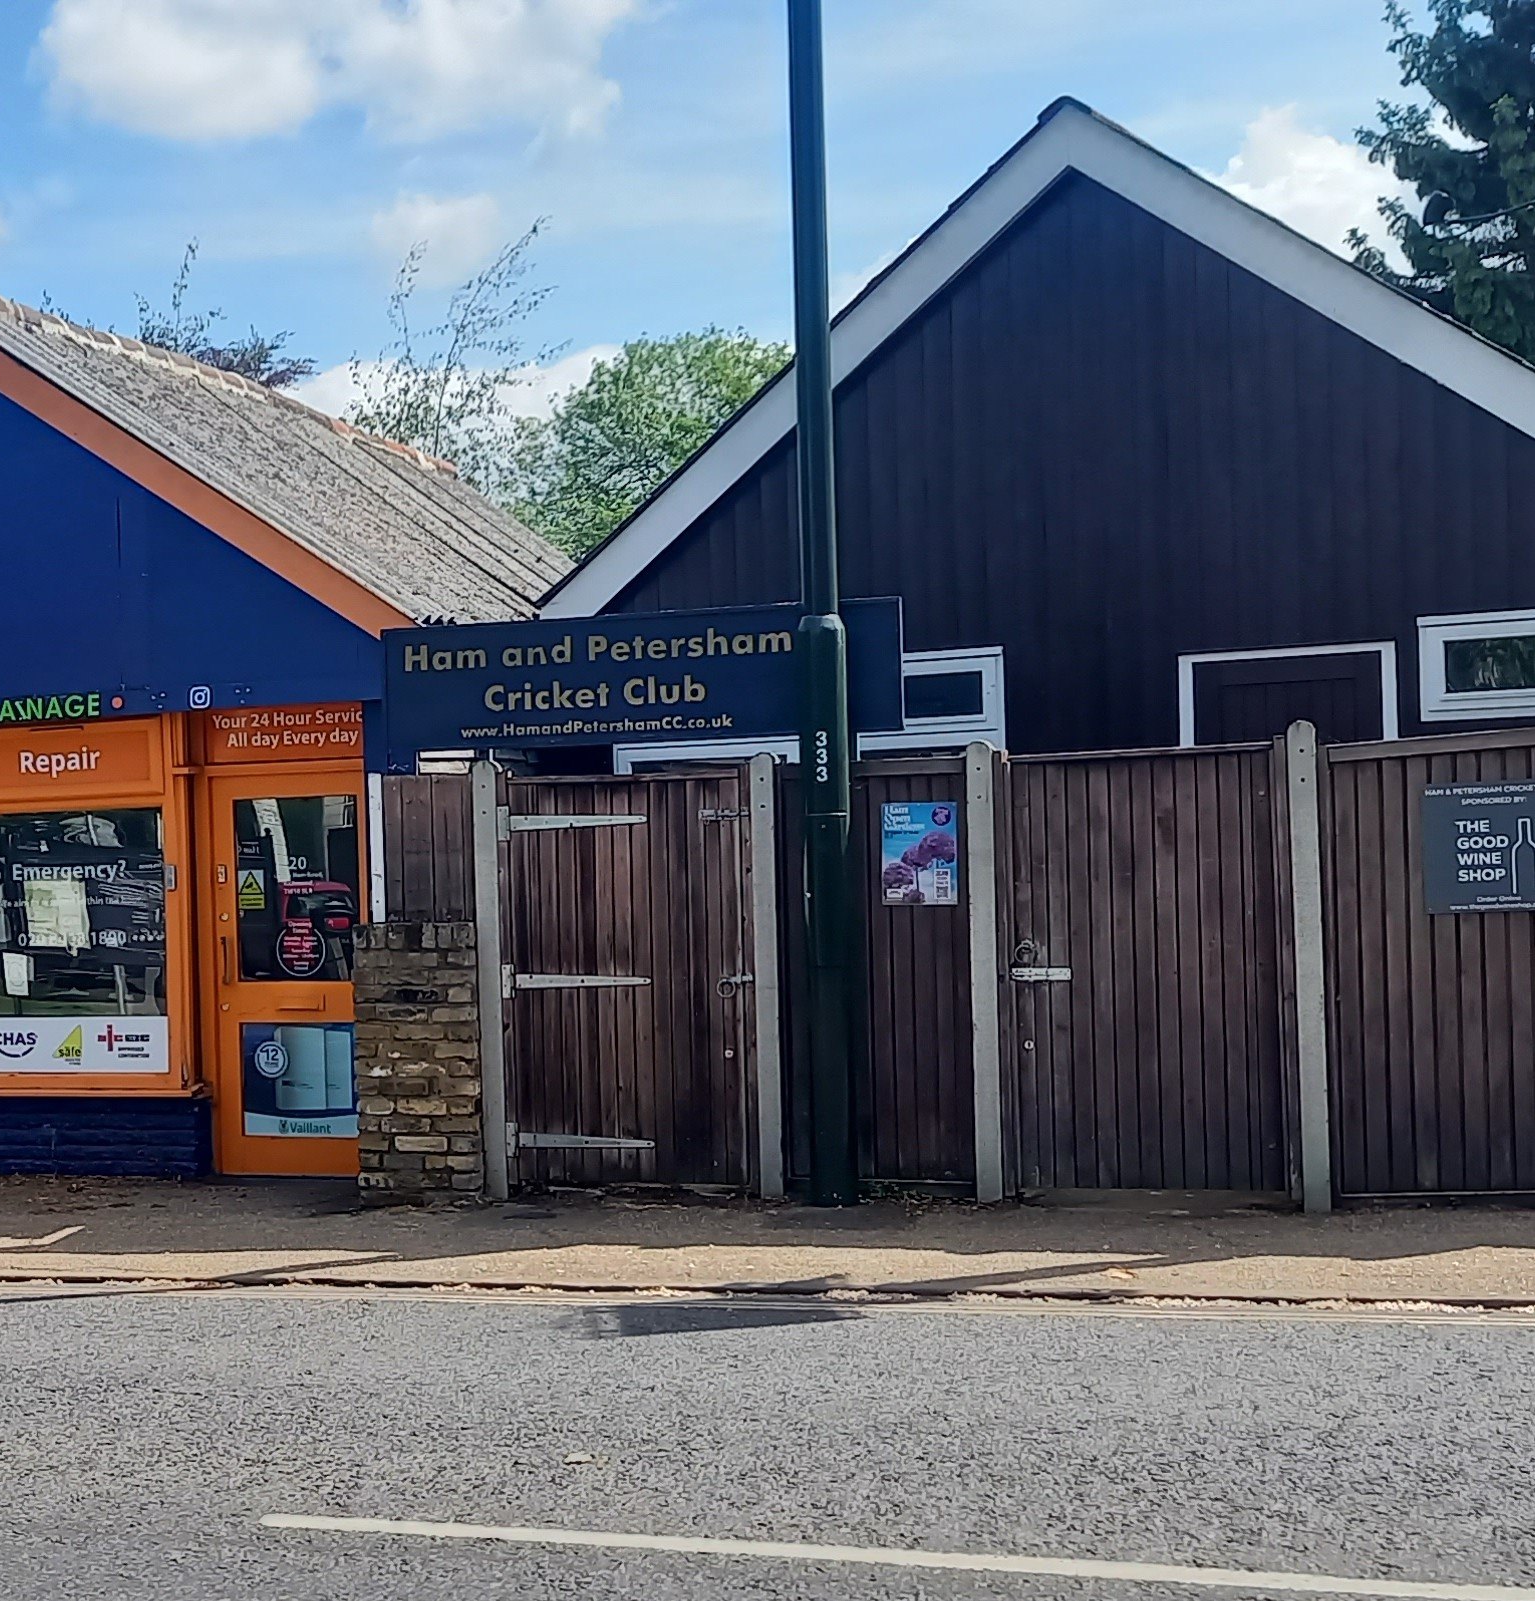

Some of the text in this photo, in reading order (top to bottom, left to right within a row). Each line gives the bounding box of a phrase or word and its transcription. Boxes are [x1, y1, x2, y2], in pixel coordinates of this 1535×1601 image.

[404, 629, 792, 672] Ham and Petersham
[484, 675, 706, 712] Cricket Club
[212, 708, 362, 729] Your 24 Hour Servic
[461, 714, 733, 738] www.HamandPetershamCC.co.uk
[227, 727, 359, 749] All day Every day
[19, 747, 101, 778] Repair
[1454, 819, 1490, 833] THE
[1456, 835, 1509, 849] GOOD
[289, 856, 307, 869] 20
[1456, 852, 1502, 865] WINE
[12, 860, 127, 883] Emergency?
[1458, 868, 1507, 881] SHOP
[260, 1048, 279, 1061] 12
[290, 1122, 332, 1134] Vaillant
